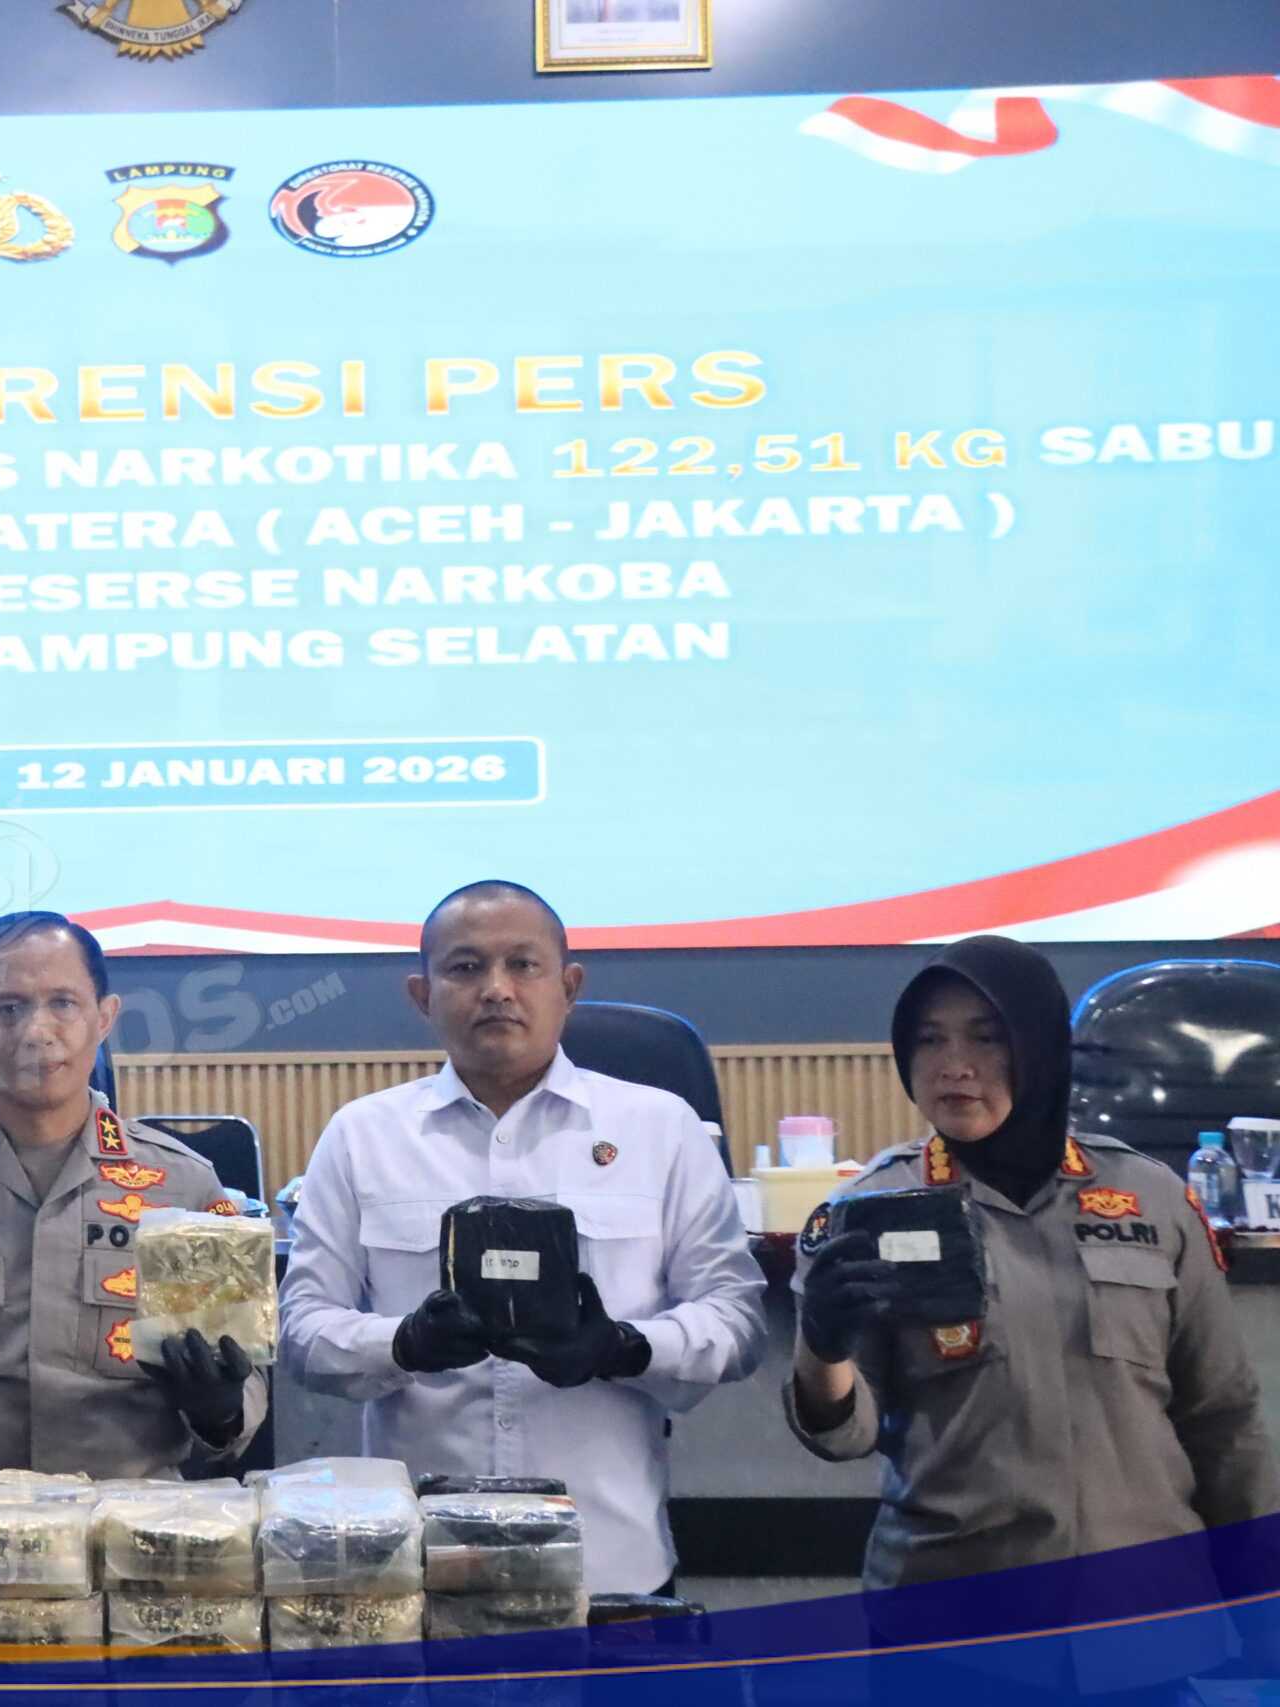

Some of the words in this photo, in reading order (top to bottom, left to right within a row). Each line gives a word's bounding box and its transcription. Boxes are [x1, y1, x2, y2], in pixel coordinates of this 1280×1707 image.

[113, 165, 227, 181] LAMPUNG
[424, 350, 767, 416] PERS
[44, 441, 518, 489] NARKOTIKA
[552, 431, 862, 480] 122,51
[894, 429, 1007, 470] KG
[1040, 420, 1274, 466] SABU
[306, 502, 525, 546] ACEH
[595, 494, 964, 540] JAKARTA
[322, 561, 732, 606] NARKOBA
[368, 622, 730, 666] SELATAN
[16, 761, 87, 790] 12
[100, 756, 346, 789] JANUARI
[362, 753, 508, 785] 2026
[1074, 1221, 1158, 1245] POLRI
